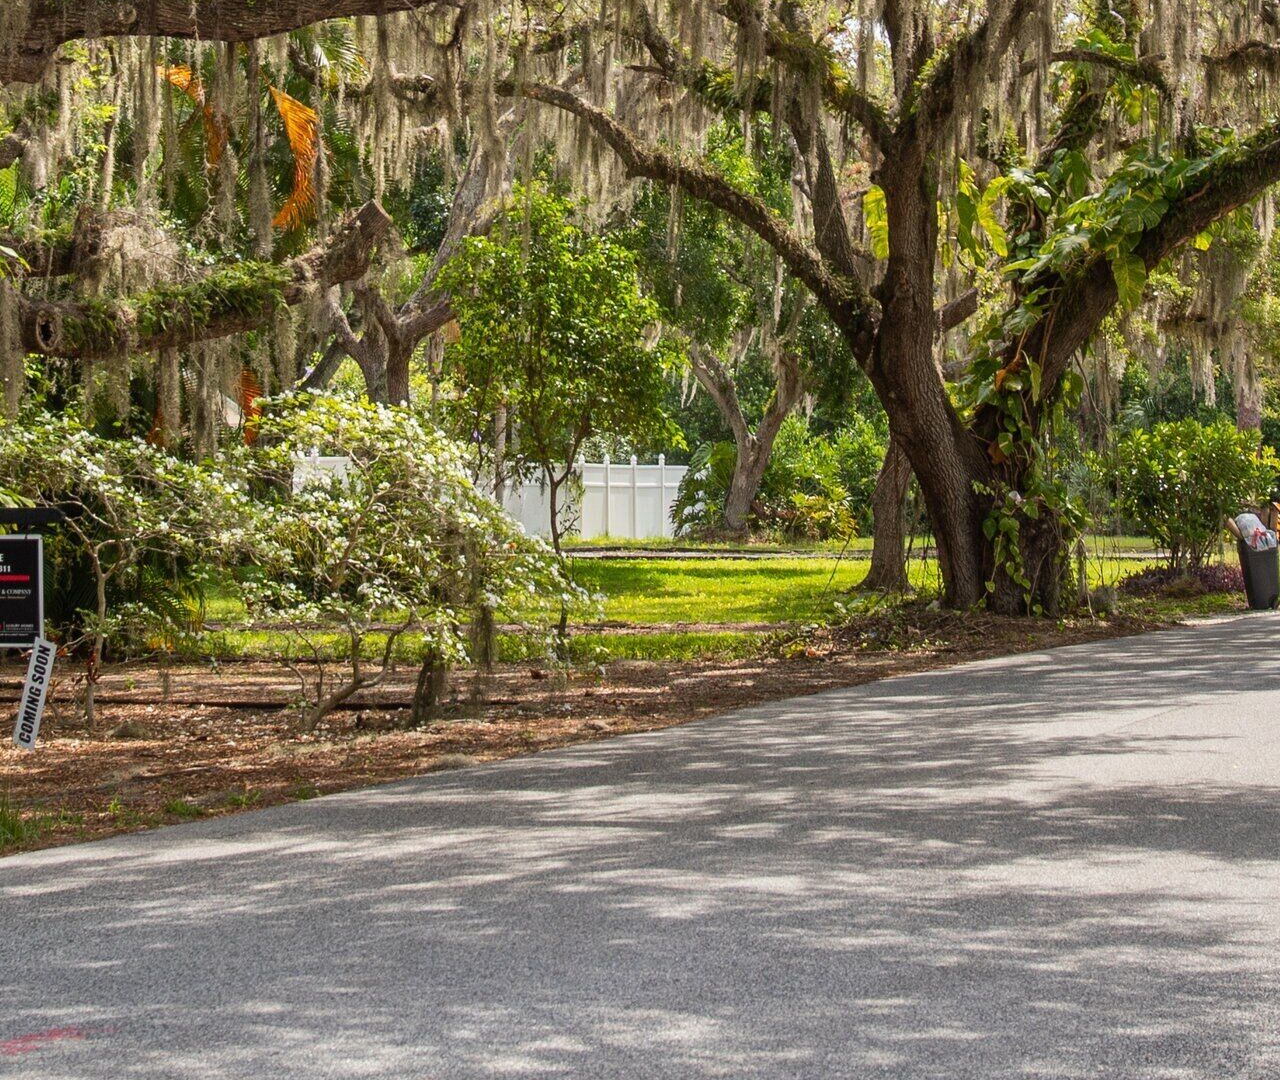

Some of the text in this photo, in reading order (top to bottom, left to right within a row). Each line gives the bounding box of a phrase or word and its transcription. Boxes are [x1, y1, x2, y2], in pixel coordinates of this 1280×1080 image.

[6, 588, 32, 596] COMPANY
[18, 644, 51, 744] COMING SOON
